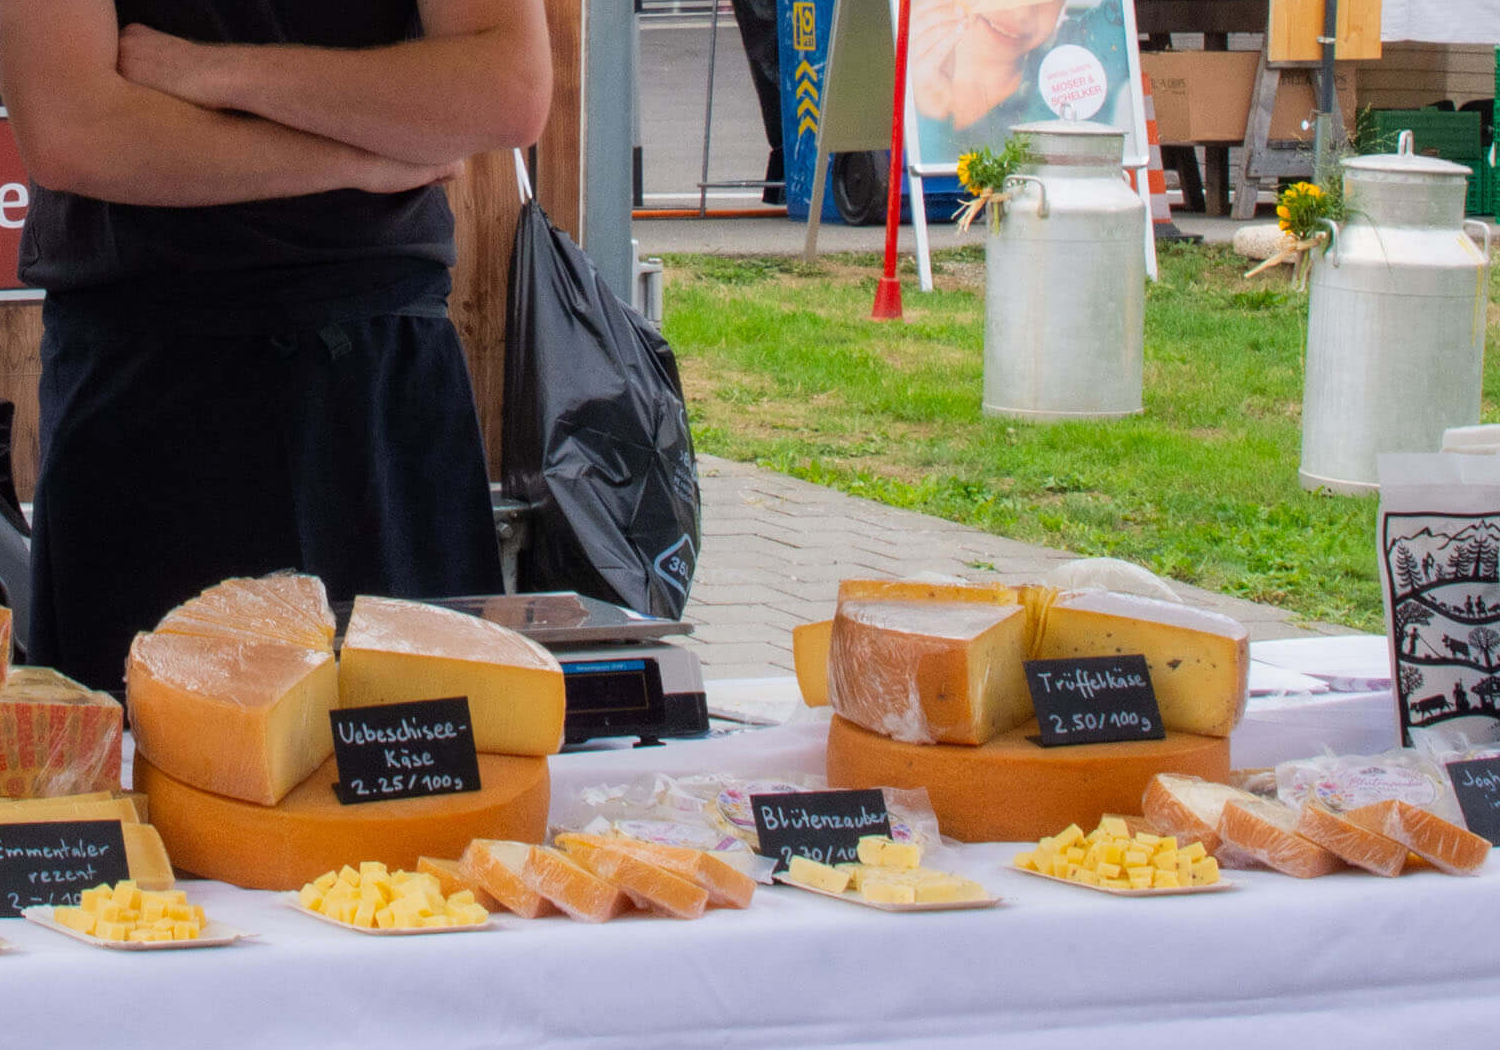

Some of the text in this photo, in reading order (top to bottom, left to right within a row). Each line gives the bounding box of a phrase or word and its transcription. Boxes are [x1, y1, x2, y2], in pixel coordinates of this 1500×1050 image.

[1037, 667, 1147, 699] Trüffelkäse
[338, 717, 467, 745] Uebeschisee-
[384, 749, 435, 768] Käse
[761, 804, 891, 831] Blütenzauber
[28, 864, 98, 884] rezent
